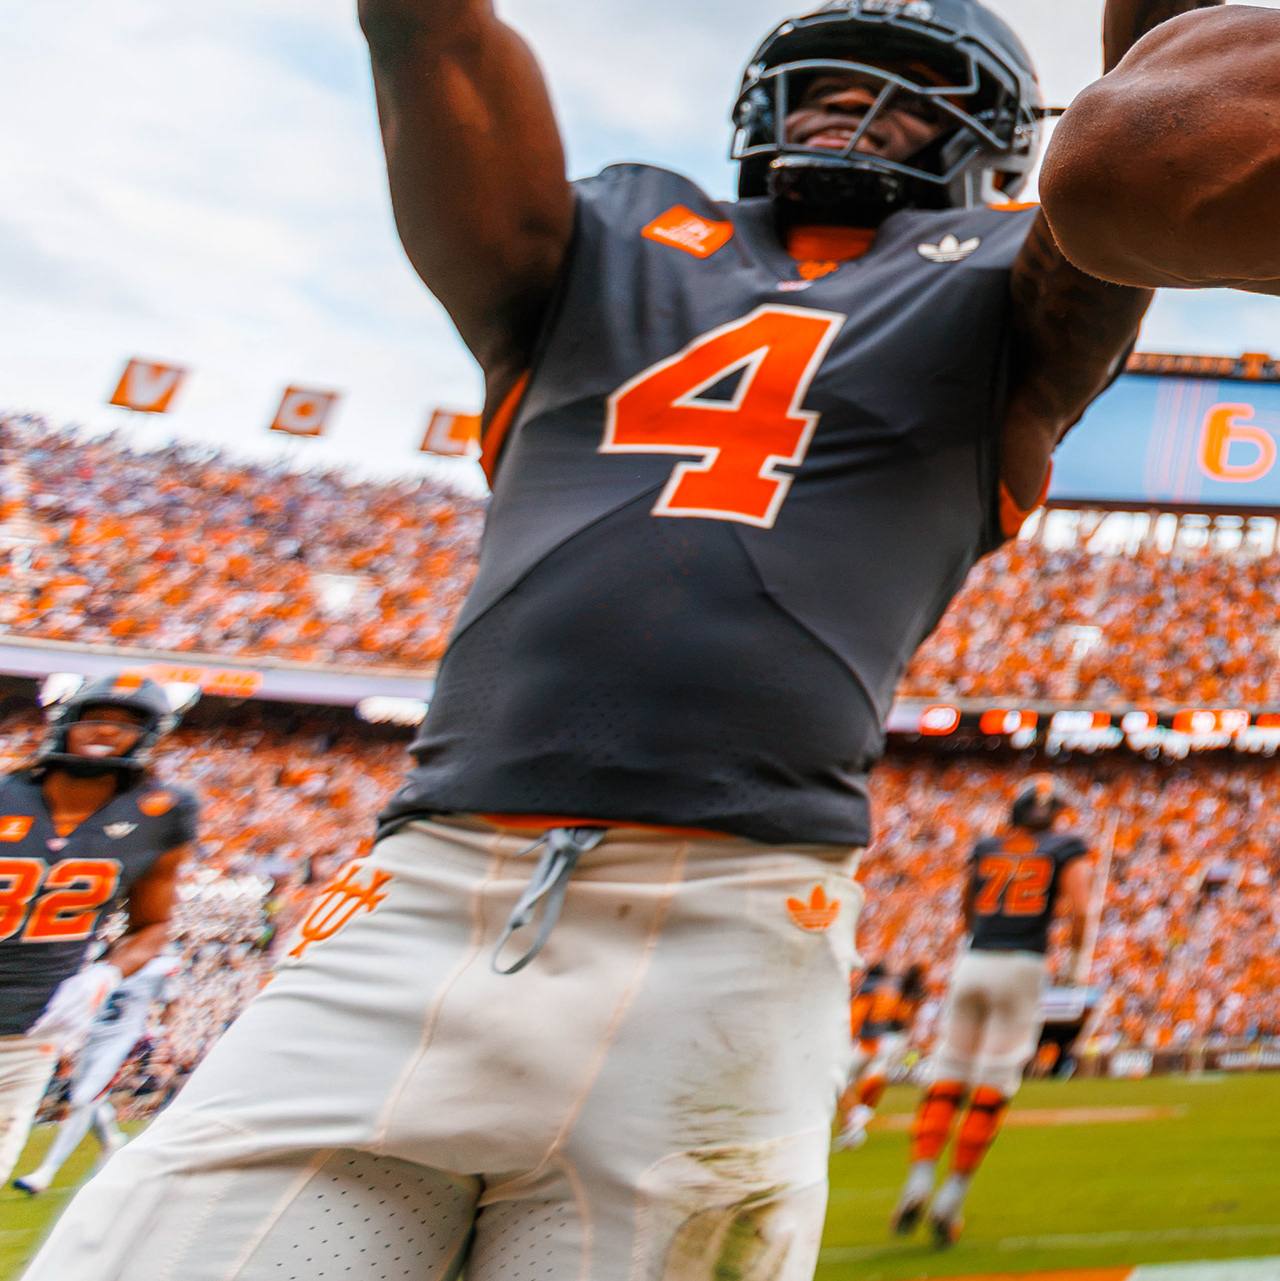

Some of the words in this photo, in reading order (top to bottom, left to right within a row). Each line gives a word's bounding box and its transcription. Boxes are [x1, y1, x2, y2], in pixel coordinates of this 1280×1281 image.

[599, 302, 848, 530] 4
[1196, 402, 1278, 484] 6
[974, 854, 1056, 917] 72
